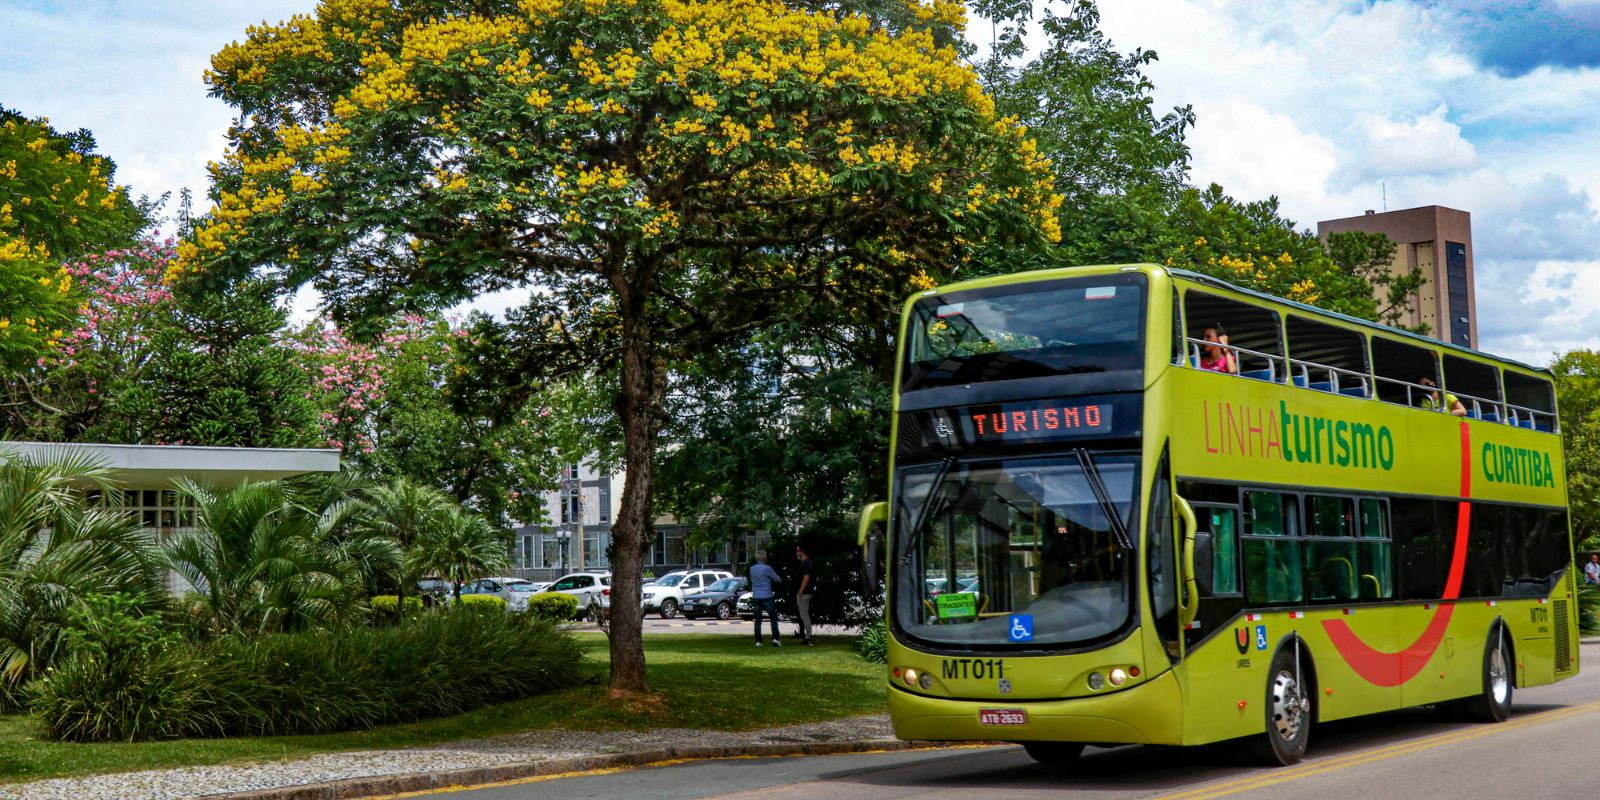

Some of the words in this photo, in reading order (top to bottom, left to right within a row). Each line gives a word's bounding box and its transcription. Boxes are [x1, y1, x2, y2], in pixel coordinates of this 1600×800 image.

[972, 405, 1100, 435] TURISMO
[1481, 441, 1555, 489] CURITIBA
[1530, 607, 1548, 624] MT011
[941, 659, 1004, 680] MT011
